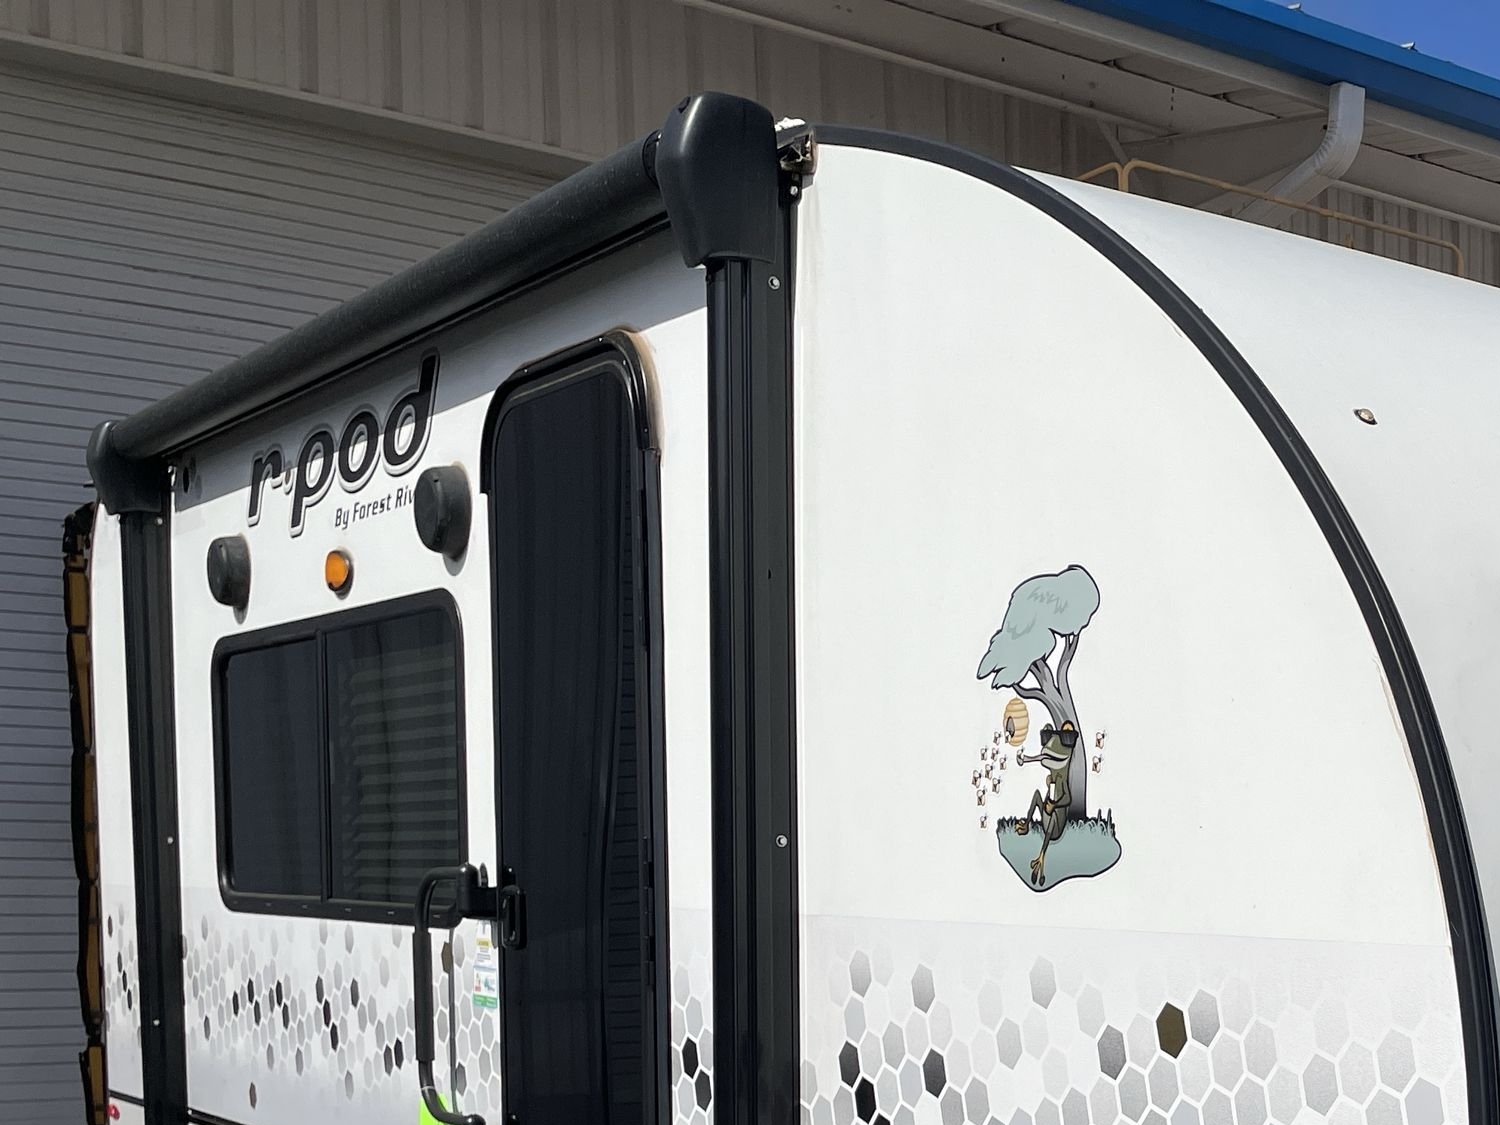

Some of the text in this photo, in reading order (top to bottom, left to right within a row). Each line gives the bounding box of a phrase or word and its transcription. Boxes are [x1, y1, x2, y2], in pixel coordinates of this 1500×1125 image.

[335, 485, 414, 531] By Forest Riv
